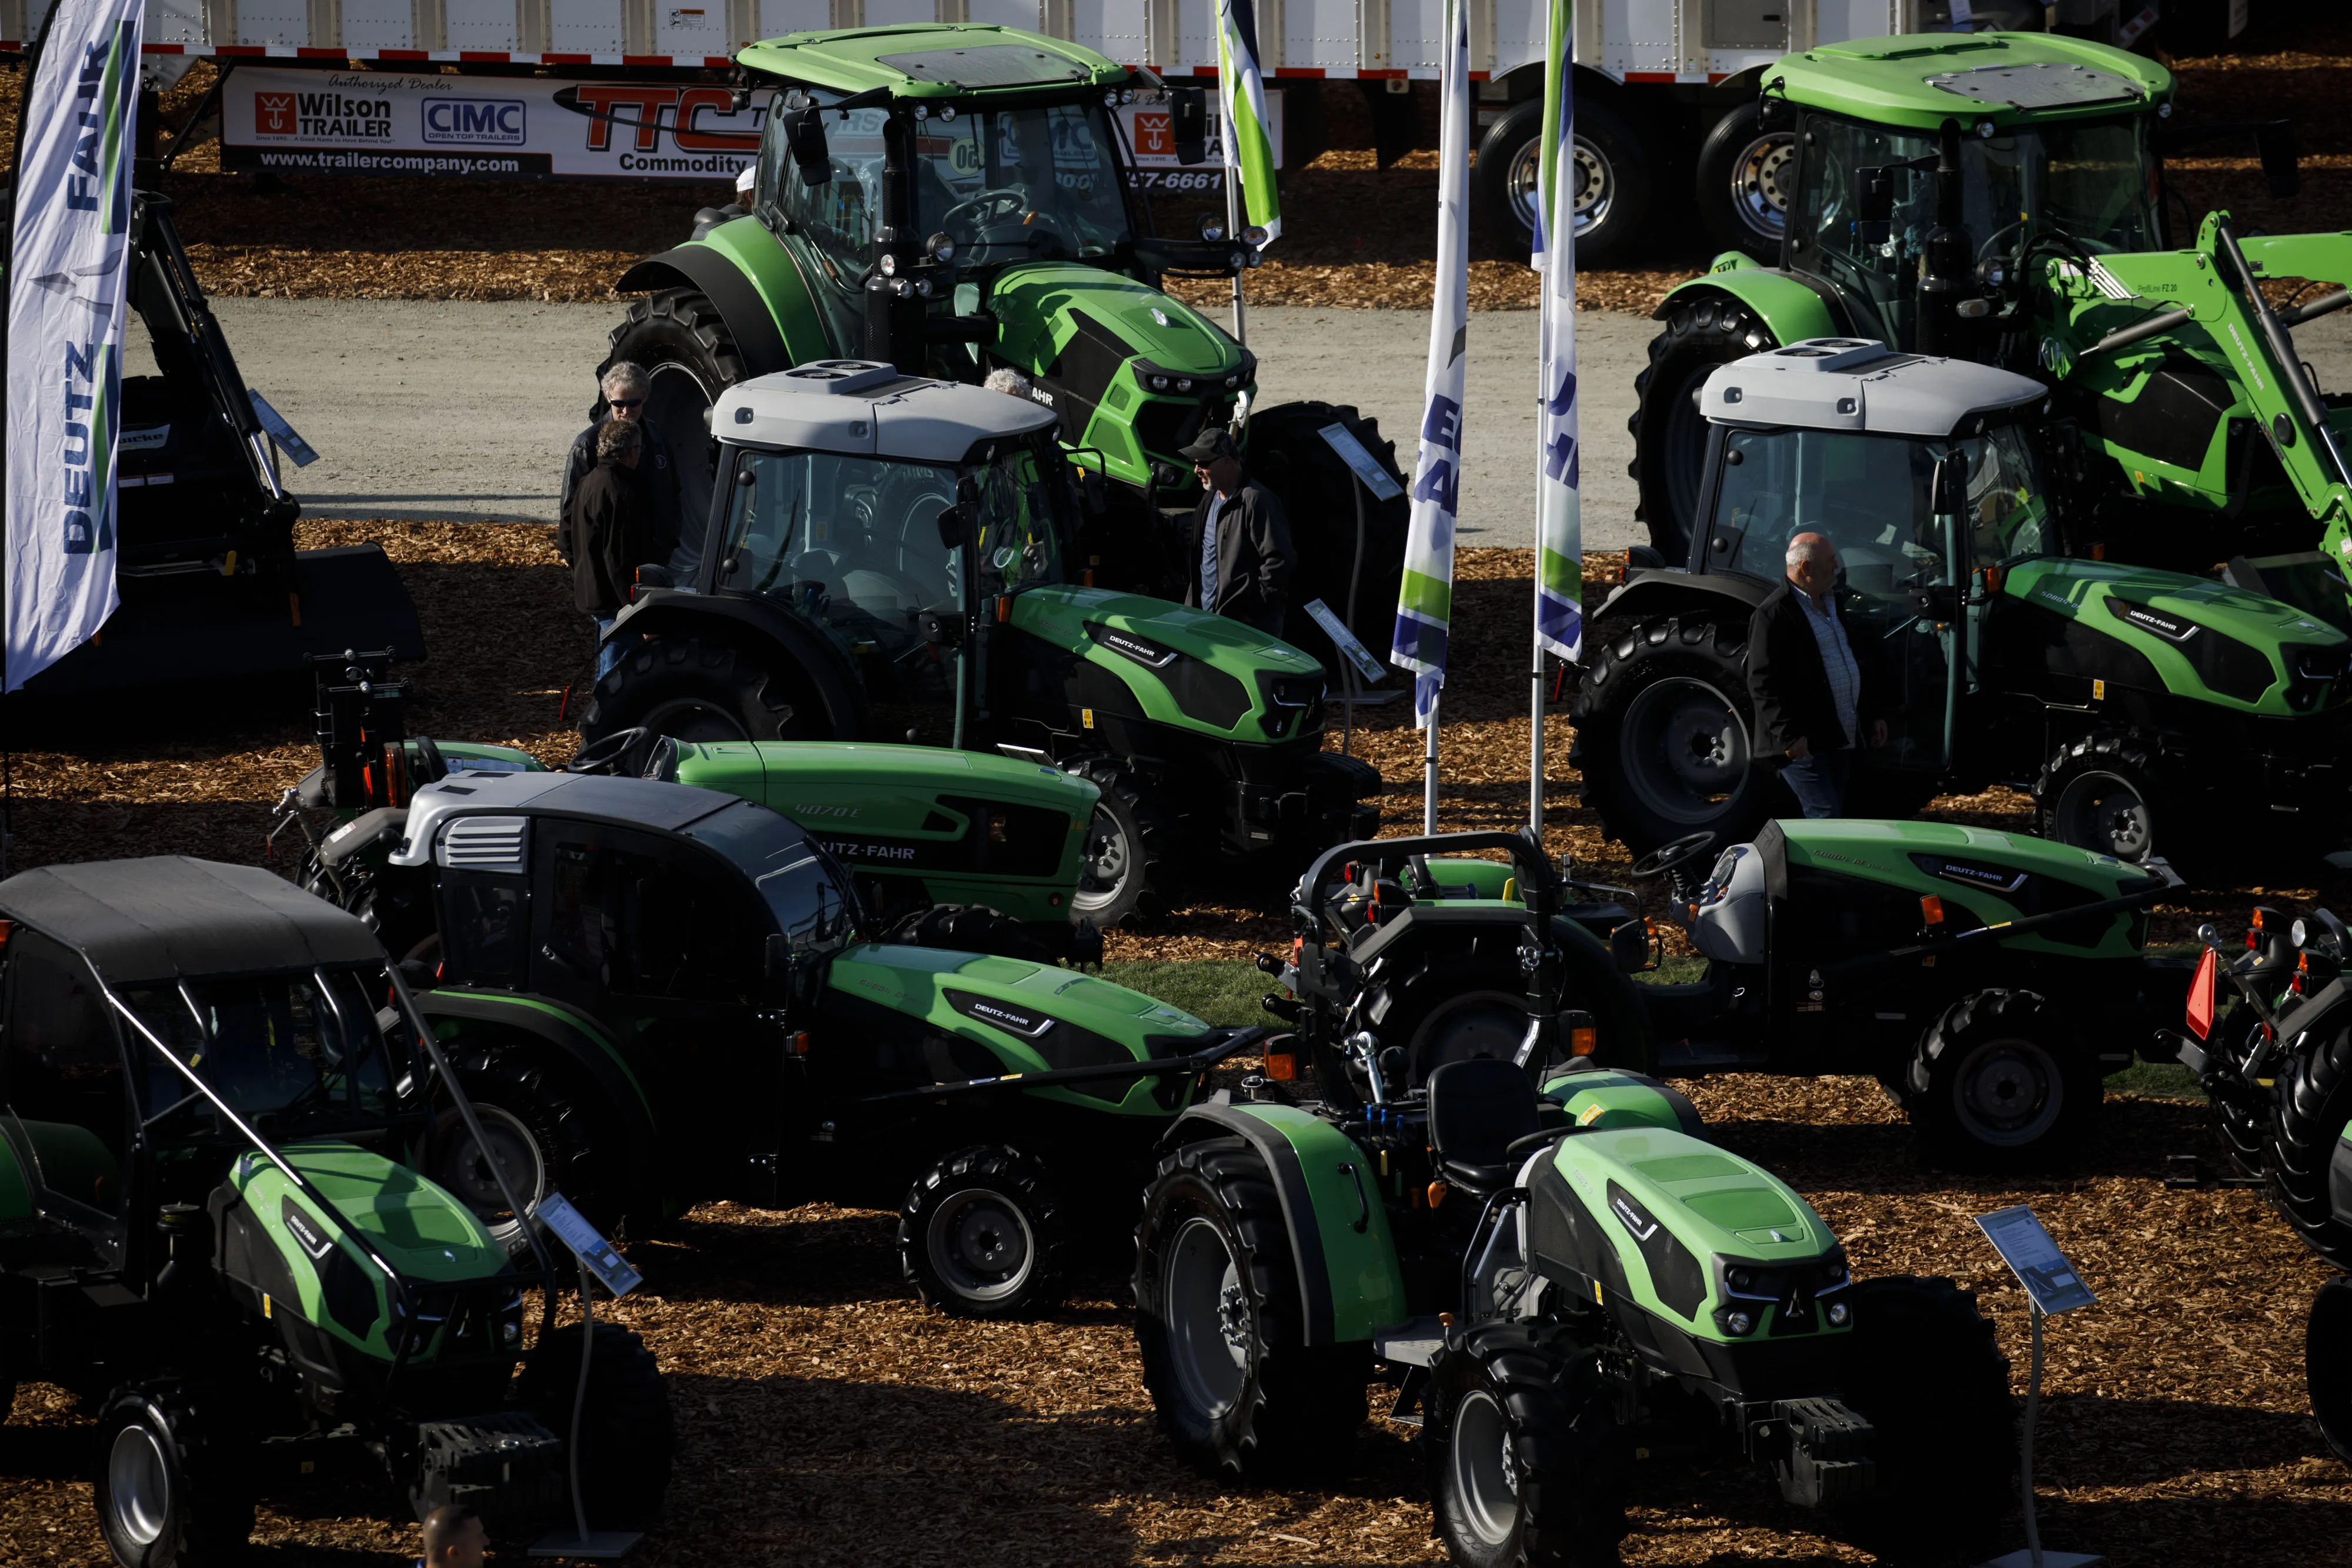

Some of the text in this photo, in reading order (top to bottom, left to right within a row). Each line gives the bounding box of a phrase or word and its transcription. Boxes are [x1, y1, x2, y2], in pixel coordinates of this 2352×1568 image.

[328, 73, 453, 95] Authorized Dealer
[298, 93, 391, 118] Wilson
[299, 118, 391, 137] TRAILER
[427, 103, 520, 134] CIMC
[576, 84, 762, 154] TTC
[260, 151, 519, 175] www.trailercompany.com
[619, 153, 747, 174] Commodity
[2228, 323, 2264, 391] DEUTZ-FAHR
[63, 340, 94, 554] DEUTZ
[2130, 609, 2177, 631] DEUTZ-FAHR
[1109, 634, 1155, 657] DEUTZ-FAHR
[794, 804, 862, 818] 4070 E
[821, 841, 915, 860] UTZ-FAHR
[1945, 863, 2003, 882] DEUTZ-FAHR
[974, 1002, 1030, 1026] DEUTZ-FAHR
[1617, 1198, 1643, 1228] DEUTZ-FAHR
[290, 1215, 318, 1245] DEUTZ-FAHR
